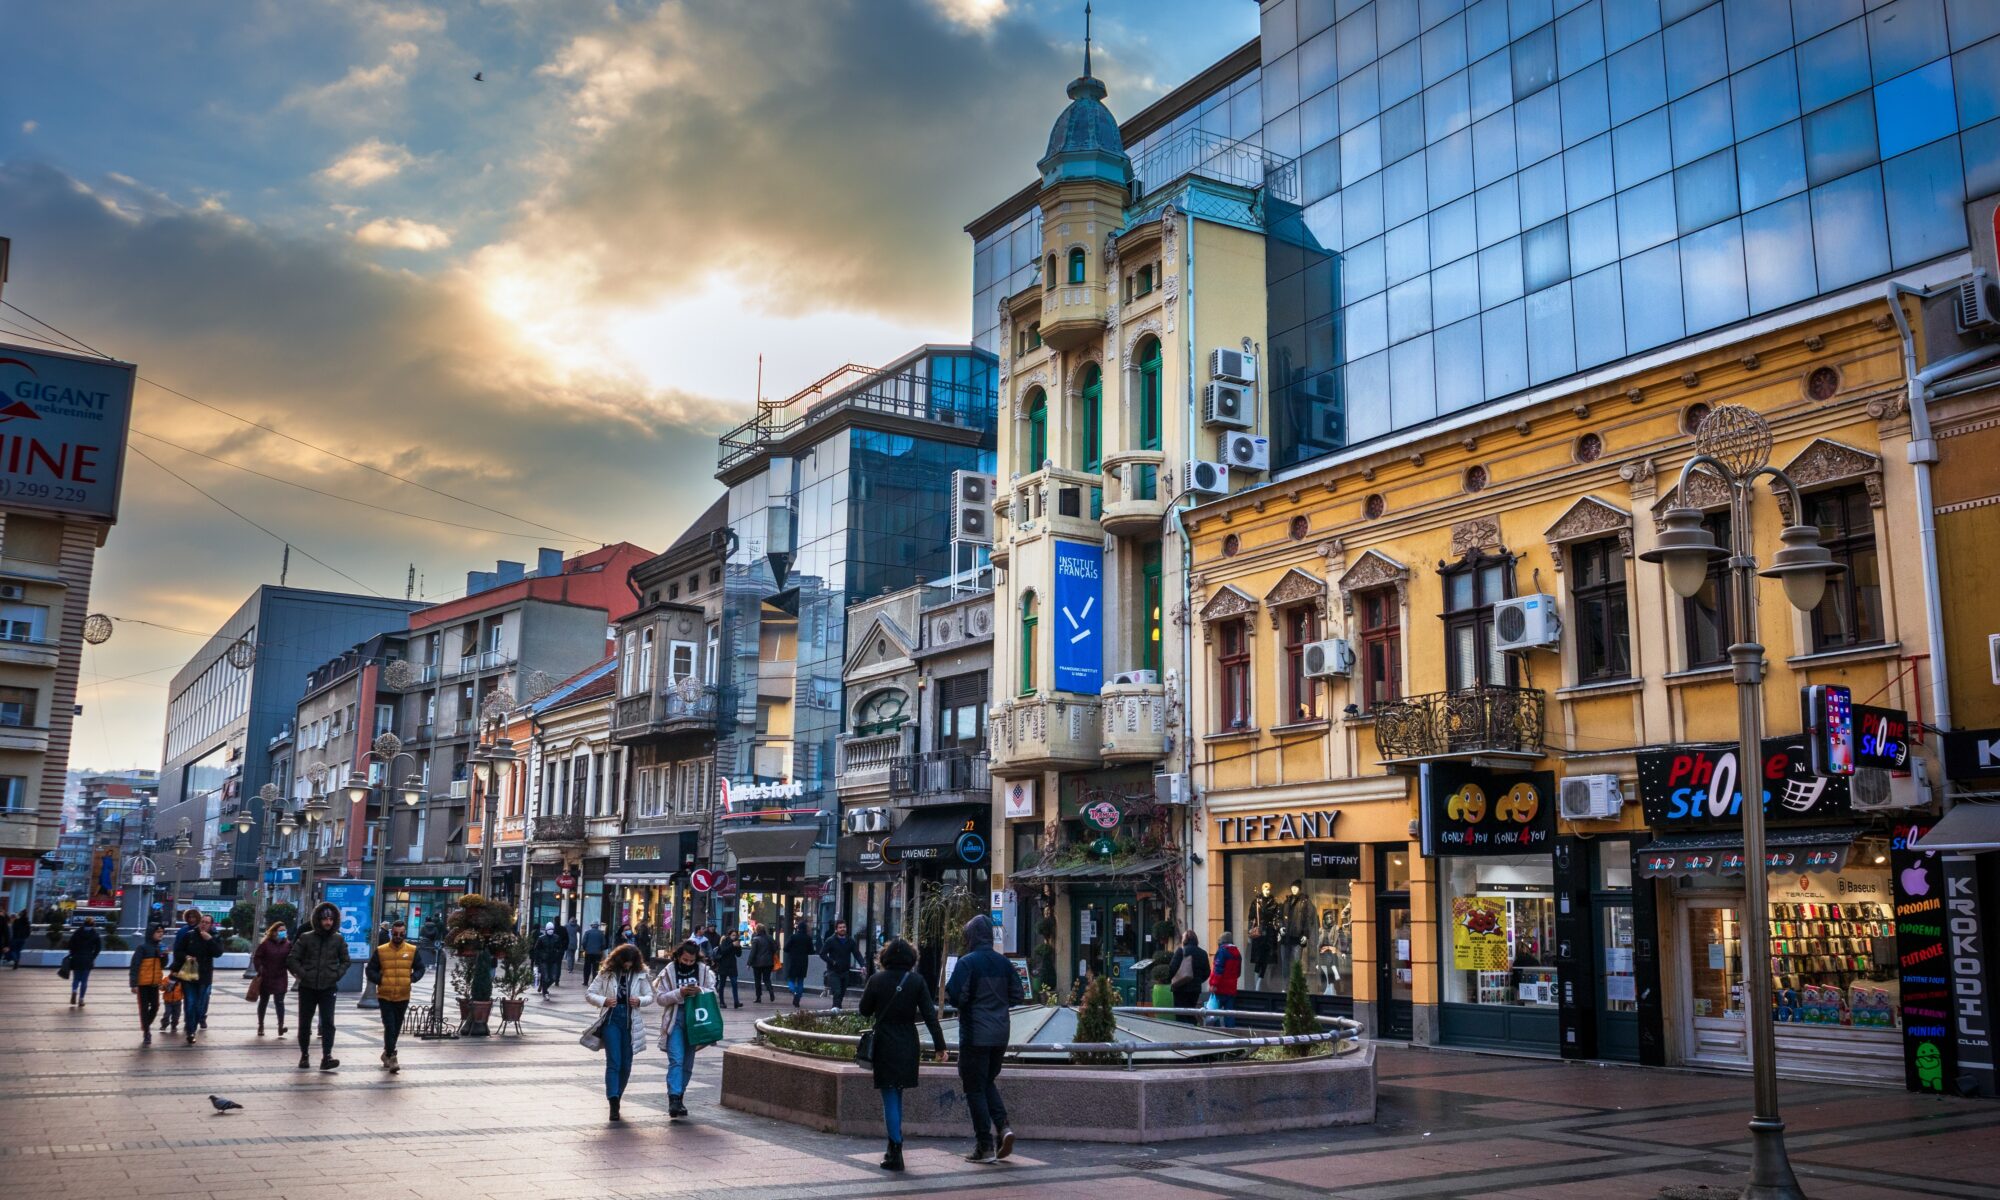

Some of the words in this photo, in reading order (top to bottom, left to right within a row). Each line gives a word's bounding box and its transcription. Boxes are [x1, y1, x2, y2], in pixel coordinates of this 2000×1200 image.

[15, 381, 110, 410] GIGANT
[34, 402, 104, 421] nekretnine
[16, 481, 49, 498] 299
[54, 486, 87, 503] 229
[1059, 565, 1098, 579] FRANÇAIS
[1060, 556, 1095, 570] INSTITUT
[1215, 810, 1341, 844] TIFFANY
[1464, 827, 1474, 846] 4
[1519, 826, 1530, 845] 4
[1322, 856, 1359, 865] TIFFANY
[1847, 881, 1876, 893] Baseus
[1899, 923, 1941, 937] OPREMA
[1901, 943, 1944, 968] FUTROLE
[1948, 877, 1986, 1036] KROKODIL
[695, 1008, 708, 1022] D
[1957, 1038, 1989, 1046] CLUB
